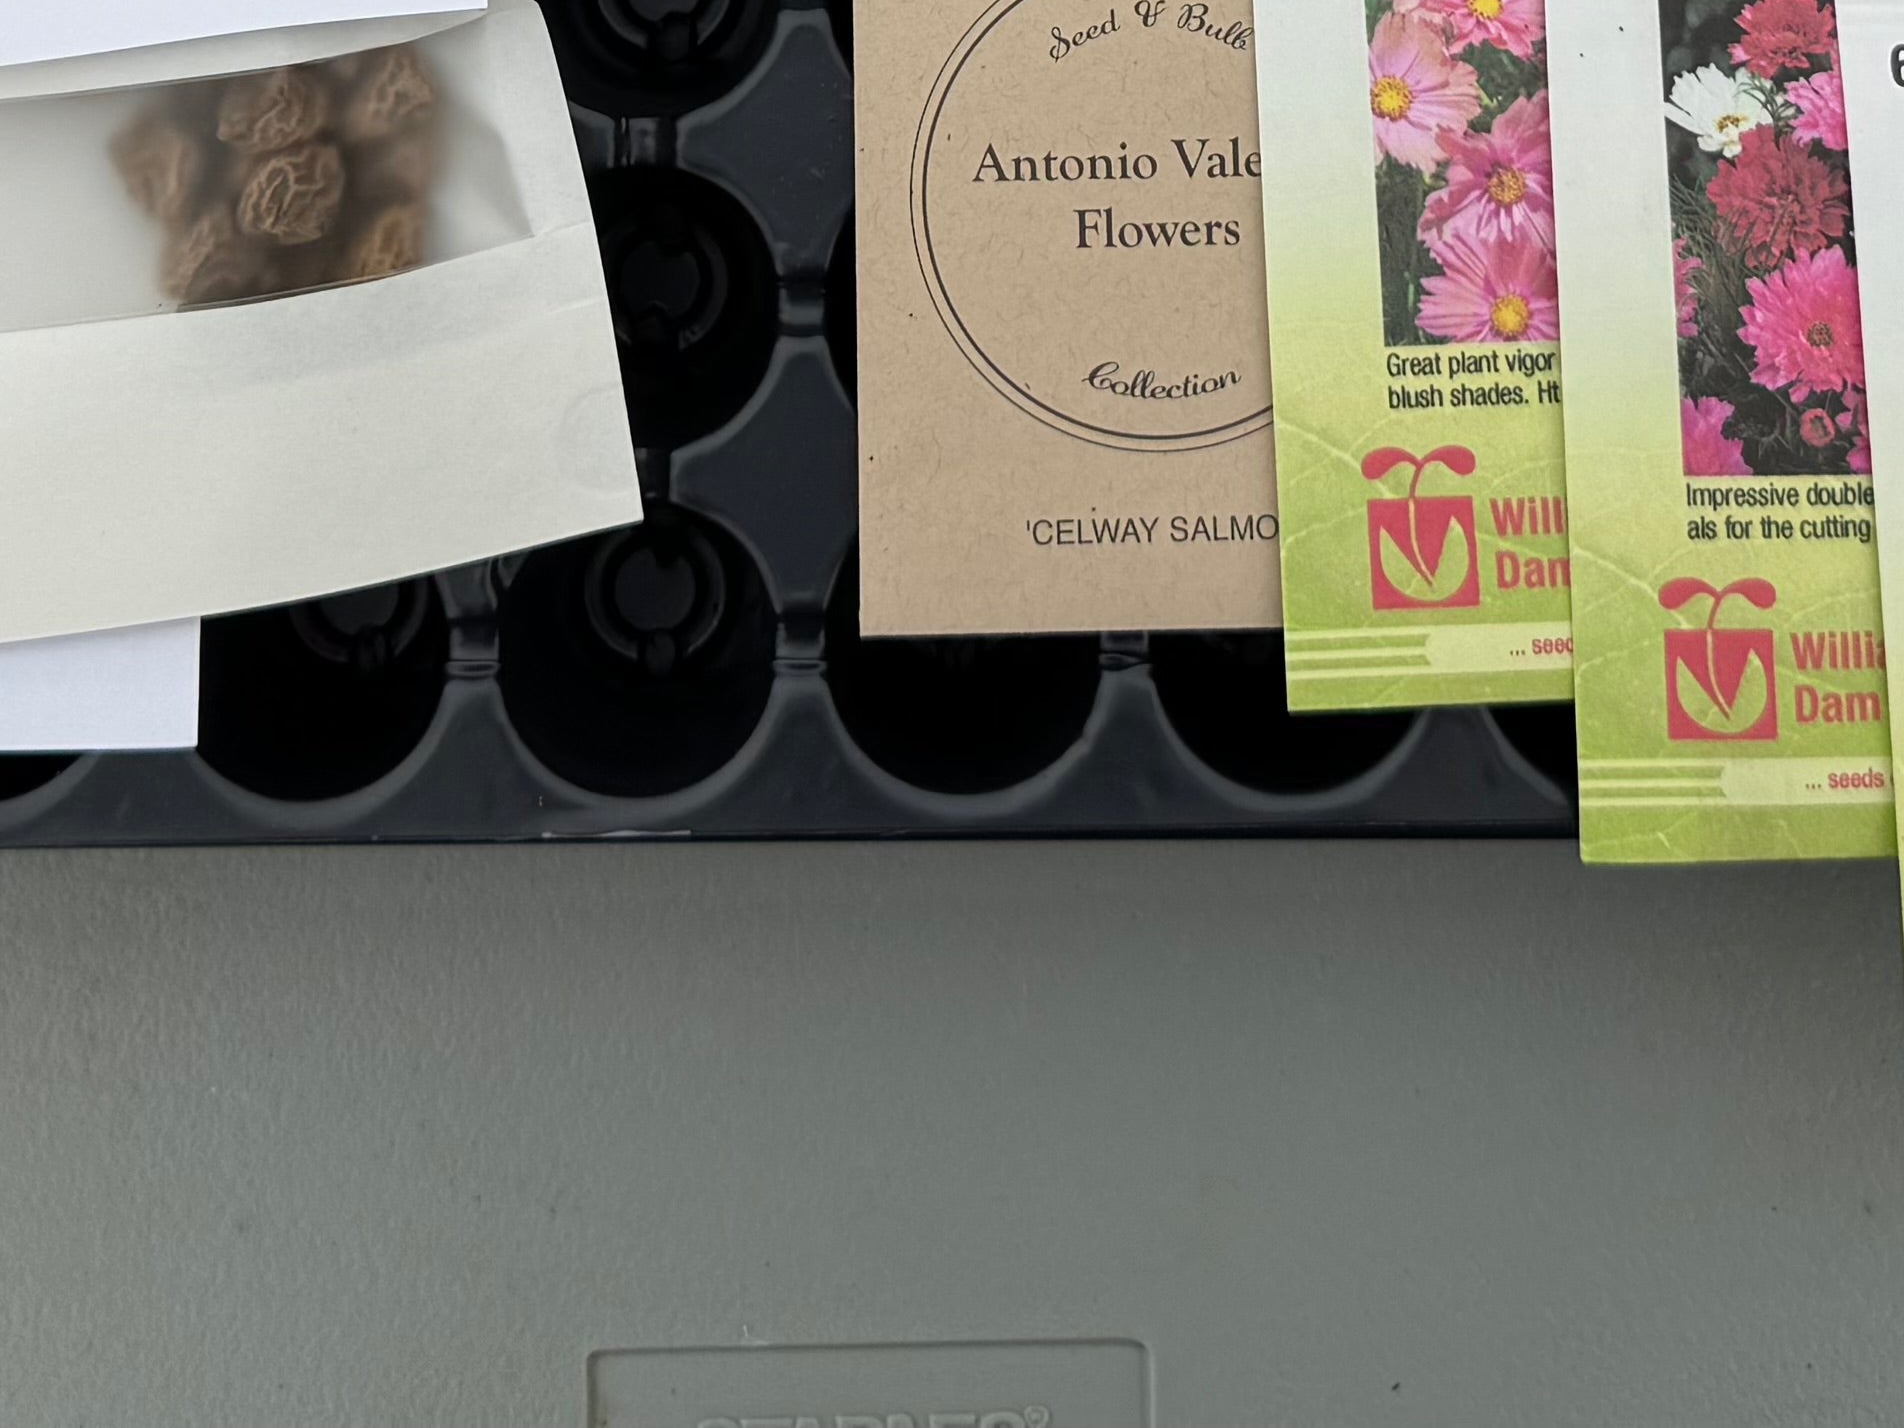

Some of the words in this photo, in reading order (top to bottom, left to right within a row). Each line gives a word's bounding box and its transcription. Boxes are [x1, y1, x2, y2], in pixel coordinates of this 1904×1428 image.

[1048, 8, 1120, 63] Seed
[972, 140, 1159, 183] Antonio
[1072, 207, 1241, 250] Flowers
[1081, 361, 1243, 400] Collection
[1386, 351, 1442, 377] Great
[1448, 350, 1500, 380] plant
[1504, 348, 1556, 377] vigor
[1387, 383, 1444, 409] blush
[1449, 381, 1530, 407] shades.
[1537, 379, 1562, 405] Ht
[1685, 481, 1800, 512] Impressive
[1806, 480, 1875, 507] double
[1686, 515, 1719, 540] als
[1724, 514, 1754, 540] for
[1759, 515, 1794, 540] the
[1799, 513, 1872, 544] cutting
[1794, 684, 1883, 724] Dam
[1827, 765, 1885, 789] seeds
